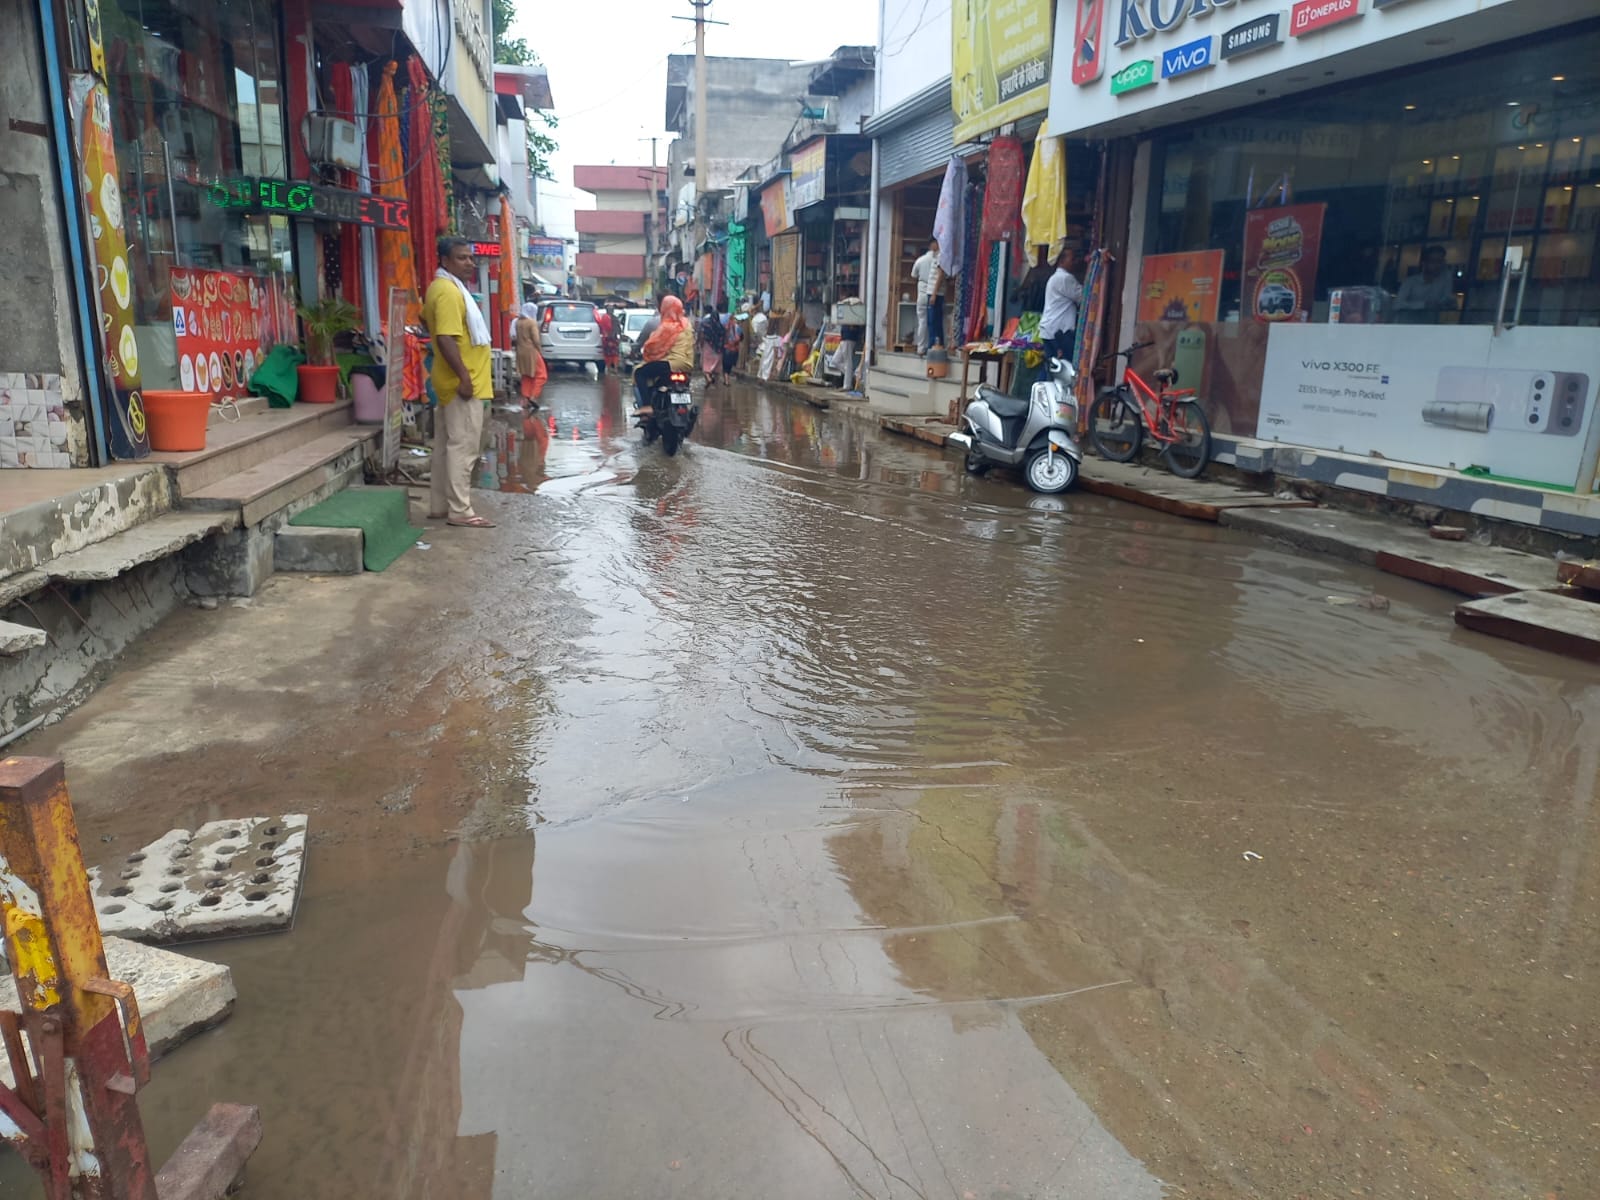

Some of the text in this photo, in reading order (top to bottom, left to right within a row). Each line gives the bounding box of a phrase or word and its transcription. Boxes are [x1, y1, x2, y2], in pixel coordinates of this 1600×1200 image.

[1310, 0, 1351, 20] ONEPLUS
[1228, 22, 1270, 49] SAMSUNG
[1166, 47, 1207, 74] vivo
[1302, 360, 1381, 374] vivo X300 FE
